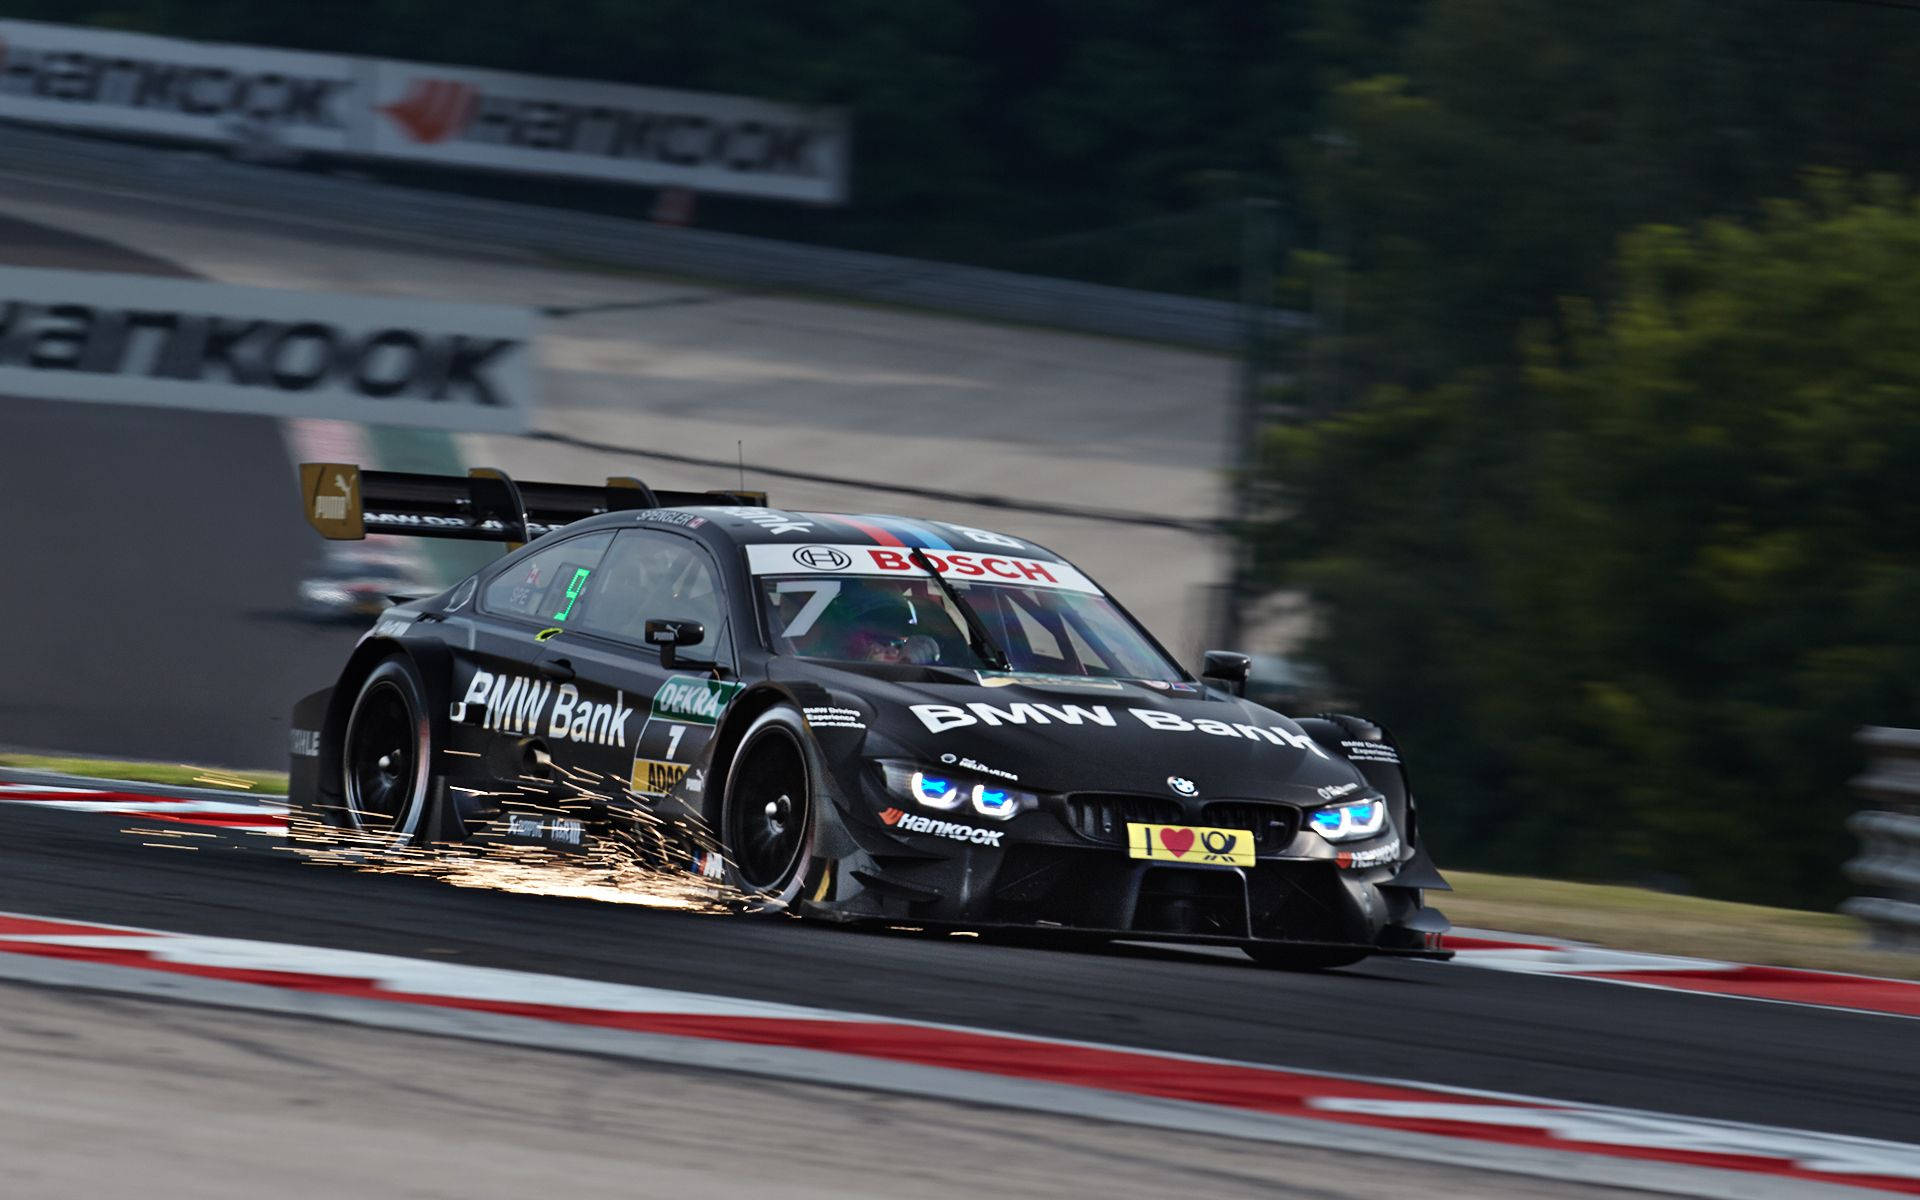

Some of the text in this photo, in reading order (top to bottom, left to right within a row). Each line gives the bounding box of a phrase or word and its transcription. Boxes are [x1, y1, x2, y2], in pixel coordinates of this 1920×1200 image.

[636, 510, 694, 526] SPENGLER
[866, 549, 1059, 584] BOSCH
[775, 580, 842, 638] 7
[549, 683, 634, 748] Bank
[660, 683, 722, 718] DEKRA
[909, 701, 1331, 760] BMW Bank
